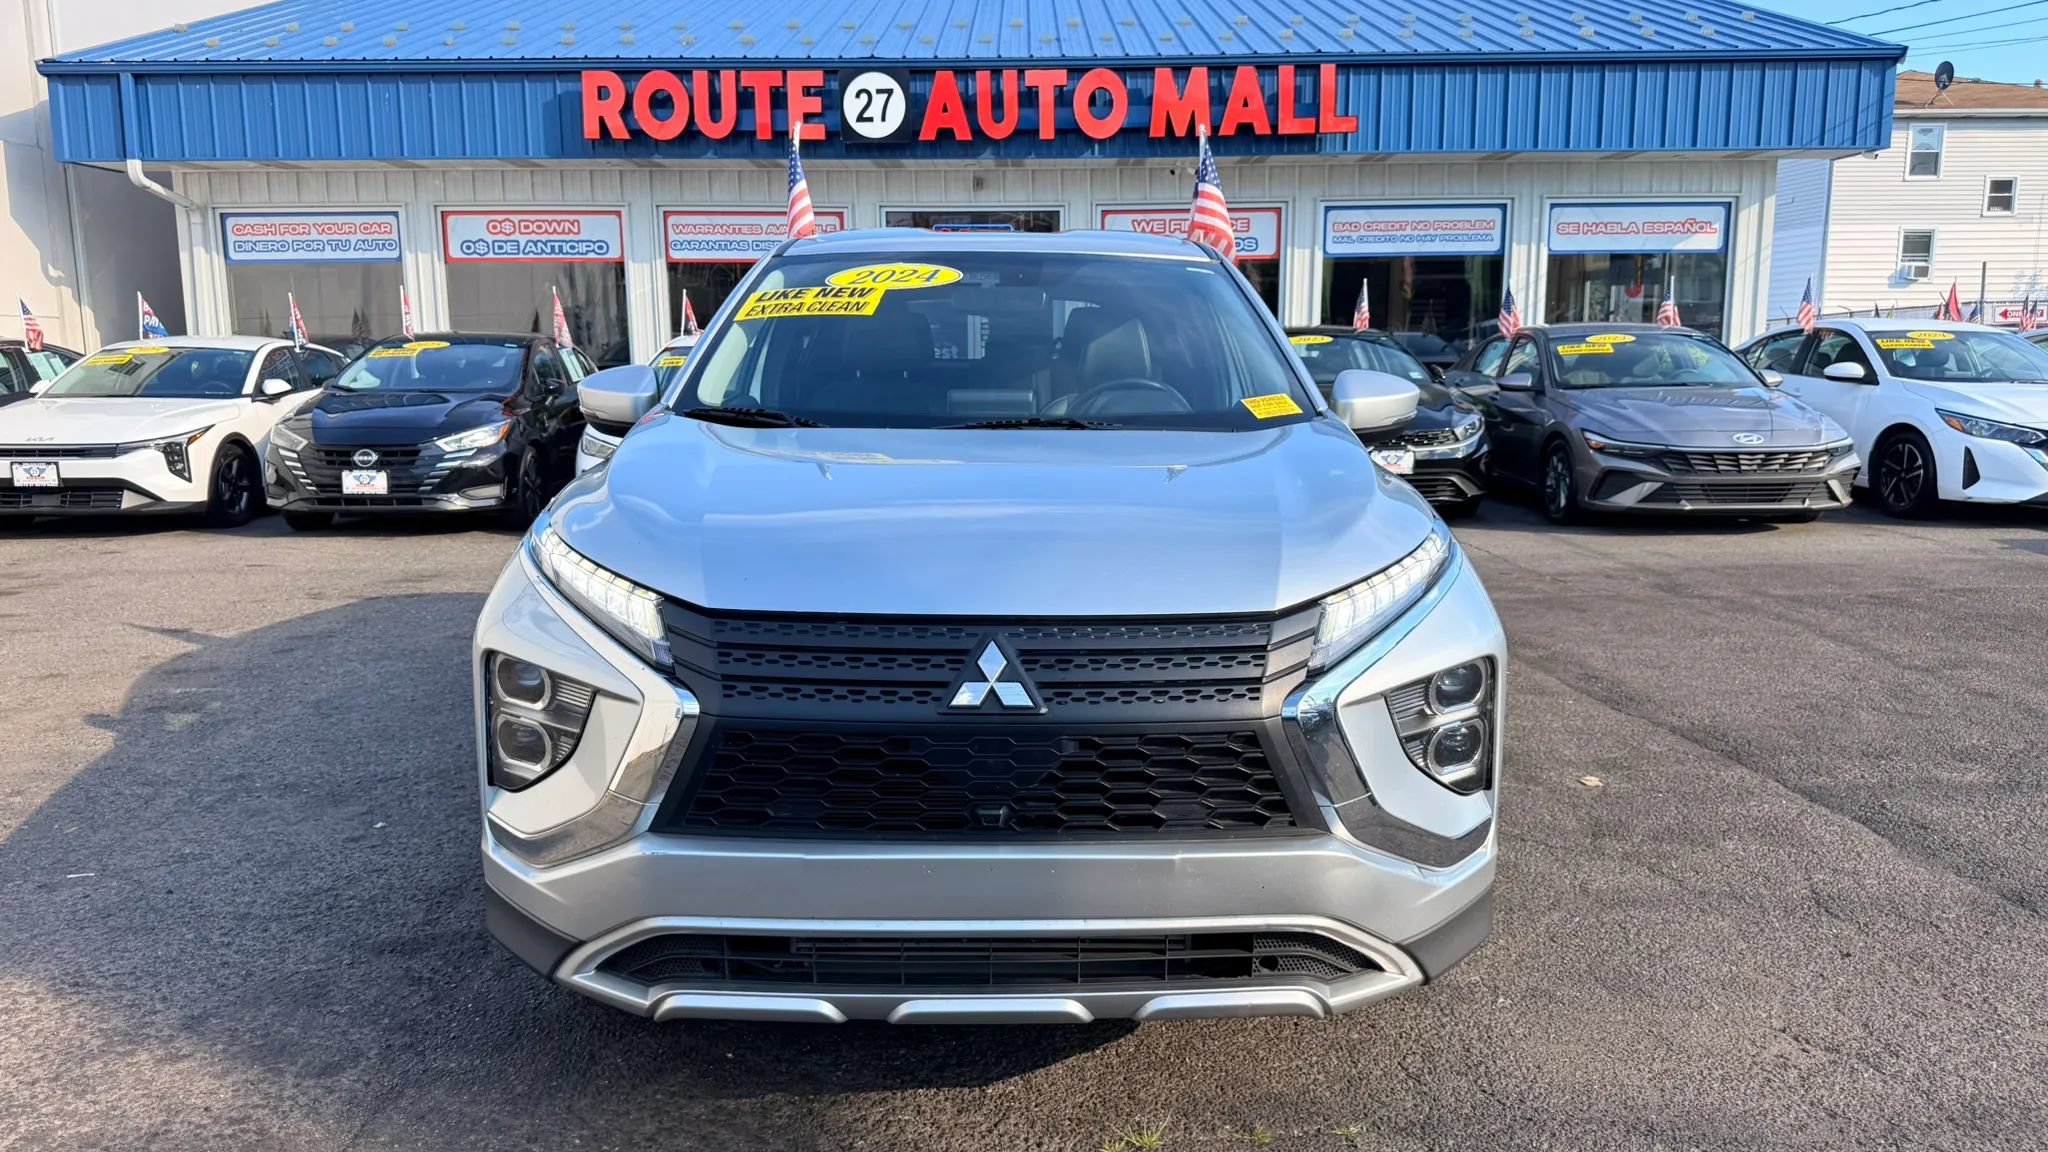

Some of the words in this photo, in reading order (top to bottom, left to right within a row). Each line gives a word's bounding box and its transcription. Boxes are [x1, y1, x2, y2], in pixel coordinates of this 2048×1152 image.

[581, 69, 827, 141] ROUTE
[854, 87, 895, 123] 27
[918, 67, 1129, 141] AUTO
[1148, 63, 1359, 138] MALL
[232, 223, 276, 236] CASH
[278, 223, 311, 236] FOR
[313, 222, 358, 235] YOUR
[359, 222, 392, 234] CAR
[518, 219, 581, 235] DOWN
[671, 223, 763, 236] WARRANTIES
[1132, 218, 1165, 233] WE
[1332, 221, 1361, 233] BAD
[1363, 220, 1409, 232] CREDIT
[1410, 220, 1432, 231] NO
[1432, 219, 1496, 231] PROBLEM
[1556, 222, 1580, 235] SE
[1582, 221, 1640, 235] HABLA
[1642, 217, 1718, 235] ESPAÑOL
[233, 239, 289, 253] DINERO
[291, 239, 324, 252] POR
[327, 239, 350, 251] TU
[353, 238, 397, 251] AUTO
[671, 239, 750, 252] GARANTIAS
[1332, 235, 1355, 244] MAL
[1356, 234, 1398, 244] CREDITO
[1399, 234, 1415, 243] NO
[1416, 234, 1438, 243] HAY
[1438, 233, 1494, 243] PROBLEMA
[492, 239, 520, 255] DE
[522, 239, 609, 255] ANTICIPO
[848, 268, 942, 285] 2024
[758, 288, 810, 303] LIKE
[811, 286, 878, 299] NEW
[744, 301, 804, 317] EXTRA
[806, 300, 871, 313] CLEAN
